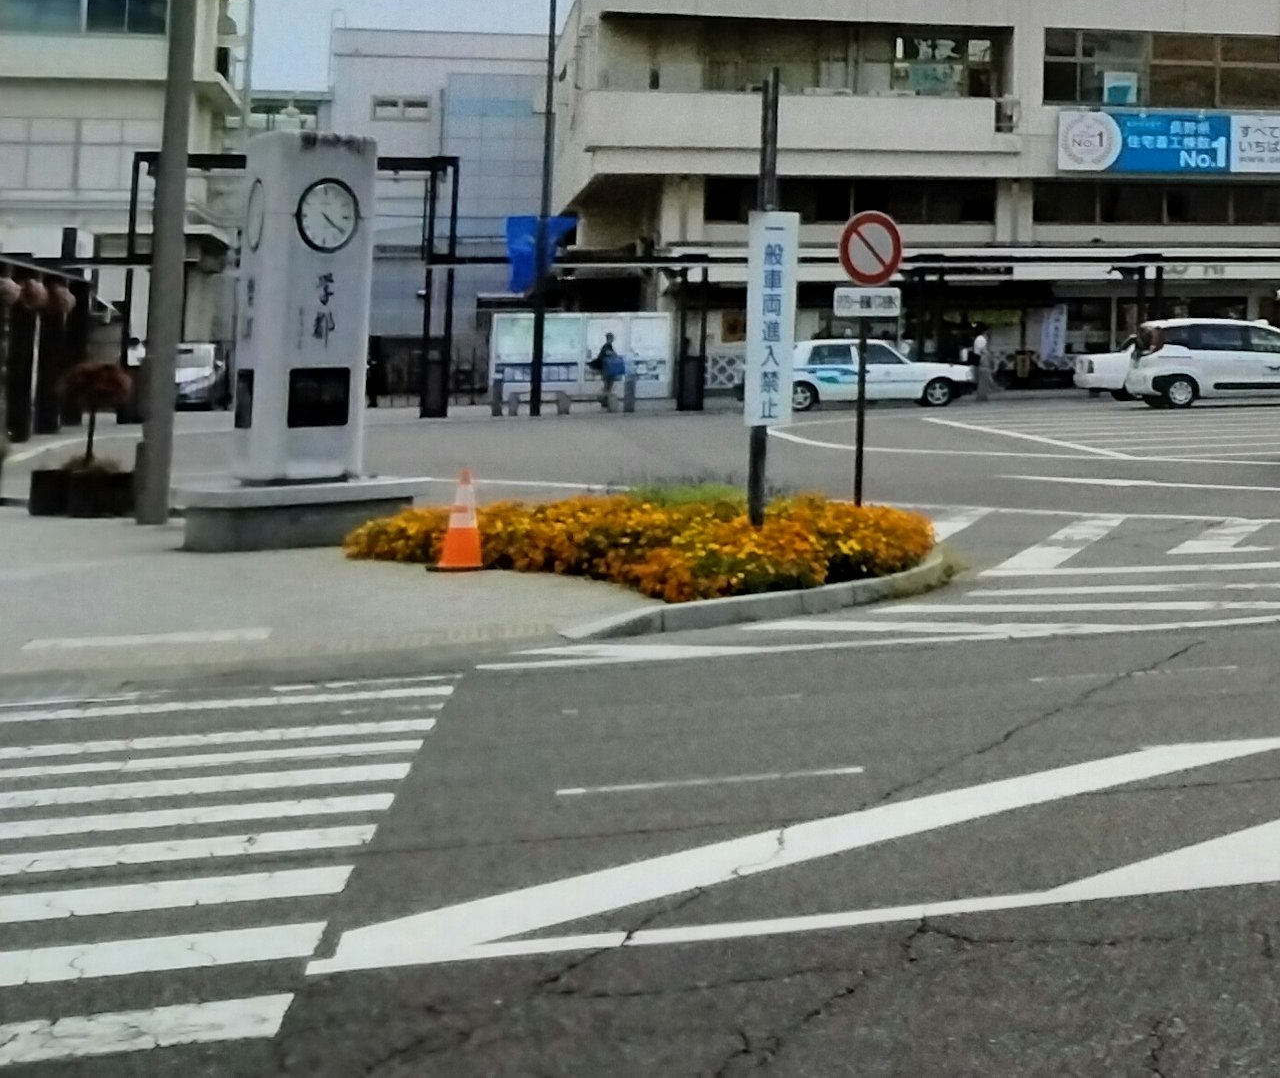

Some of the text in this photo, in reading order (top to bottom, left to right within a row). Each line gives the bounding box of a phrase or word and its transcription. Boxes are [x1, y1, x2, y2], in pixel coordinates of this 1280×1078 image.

[755, 226, 785, 420] 一般車両進入禁止
